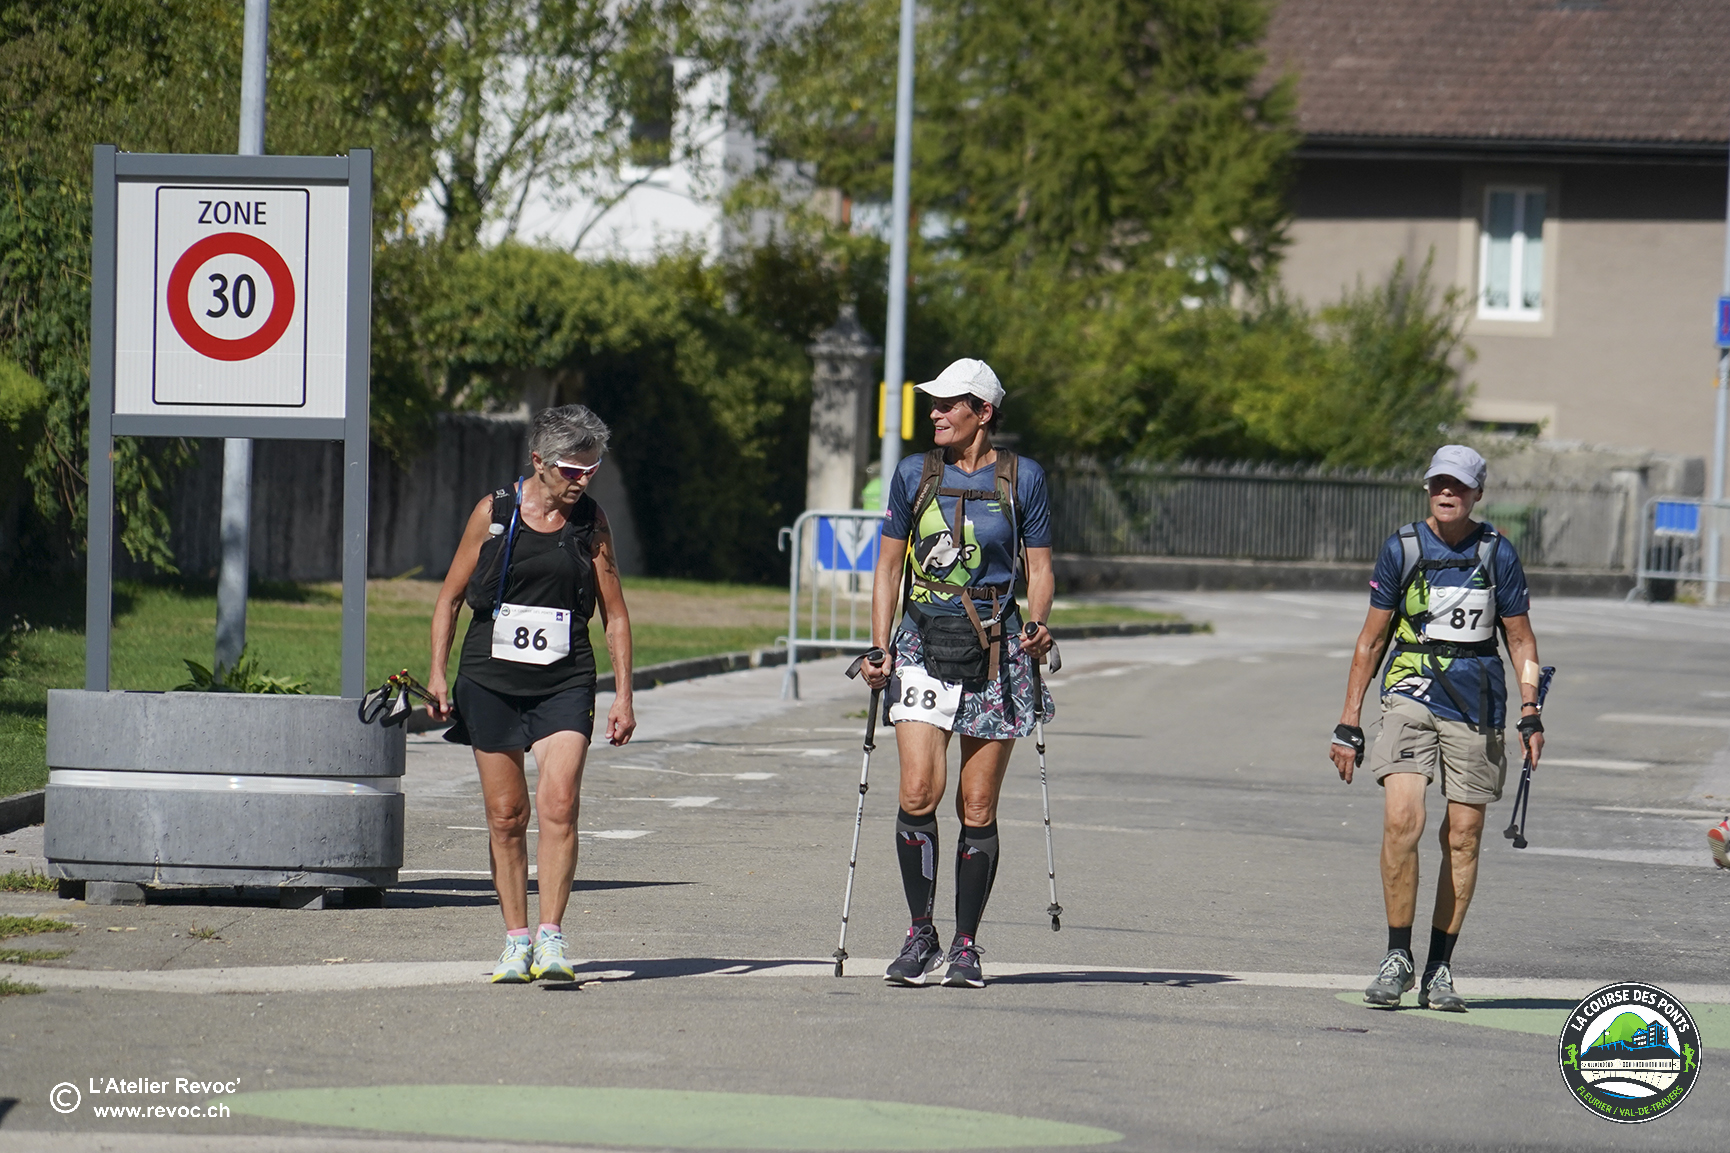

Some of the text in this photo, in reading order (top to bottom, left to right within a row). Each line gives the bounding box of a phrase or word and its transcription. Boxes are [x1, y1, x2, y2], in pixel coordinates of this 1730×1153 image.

[197, 200, 267, 225] ZONE
[205, 273, 256, 318] 30
[1449, 608, 1484, 630] 87
[513, 626, 548, 651] 86
[903, 686, 938, 710] 88
